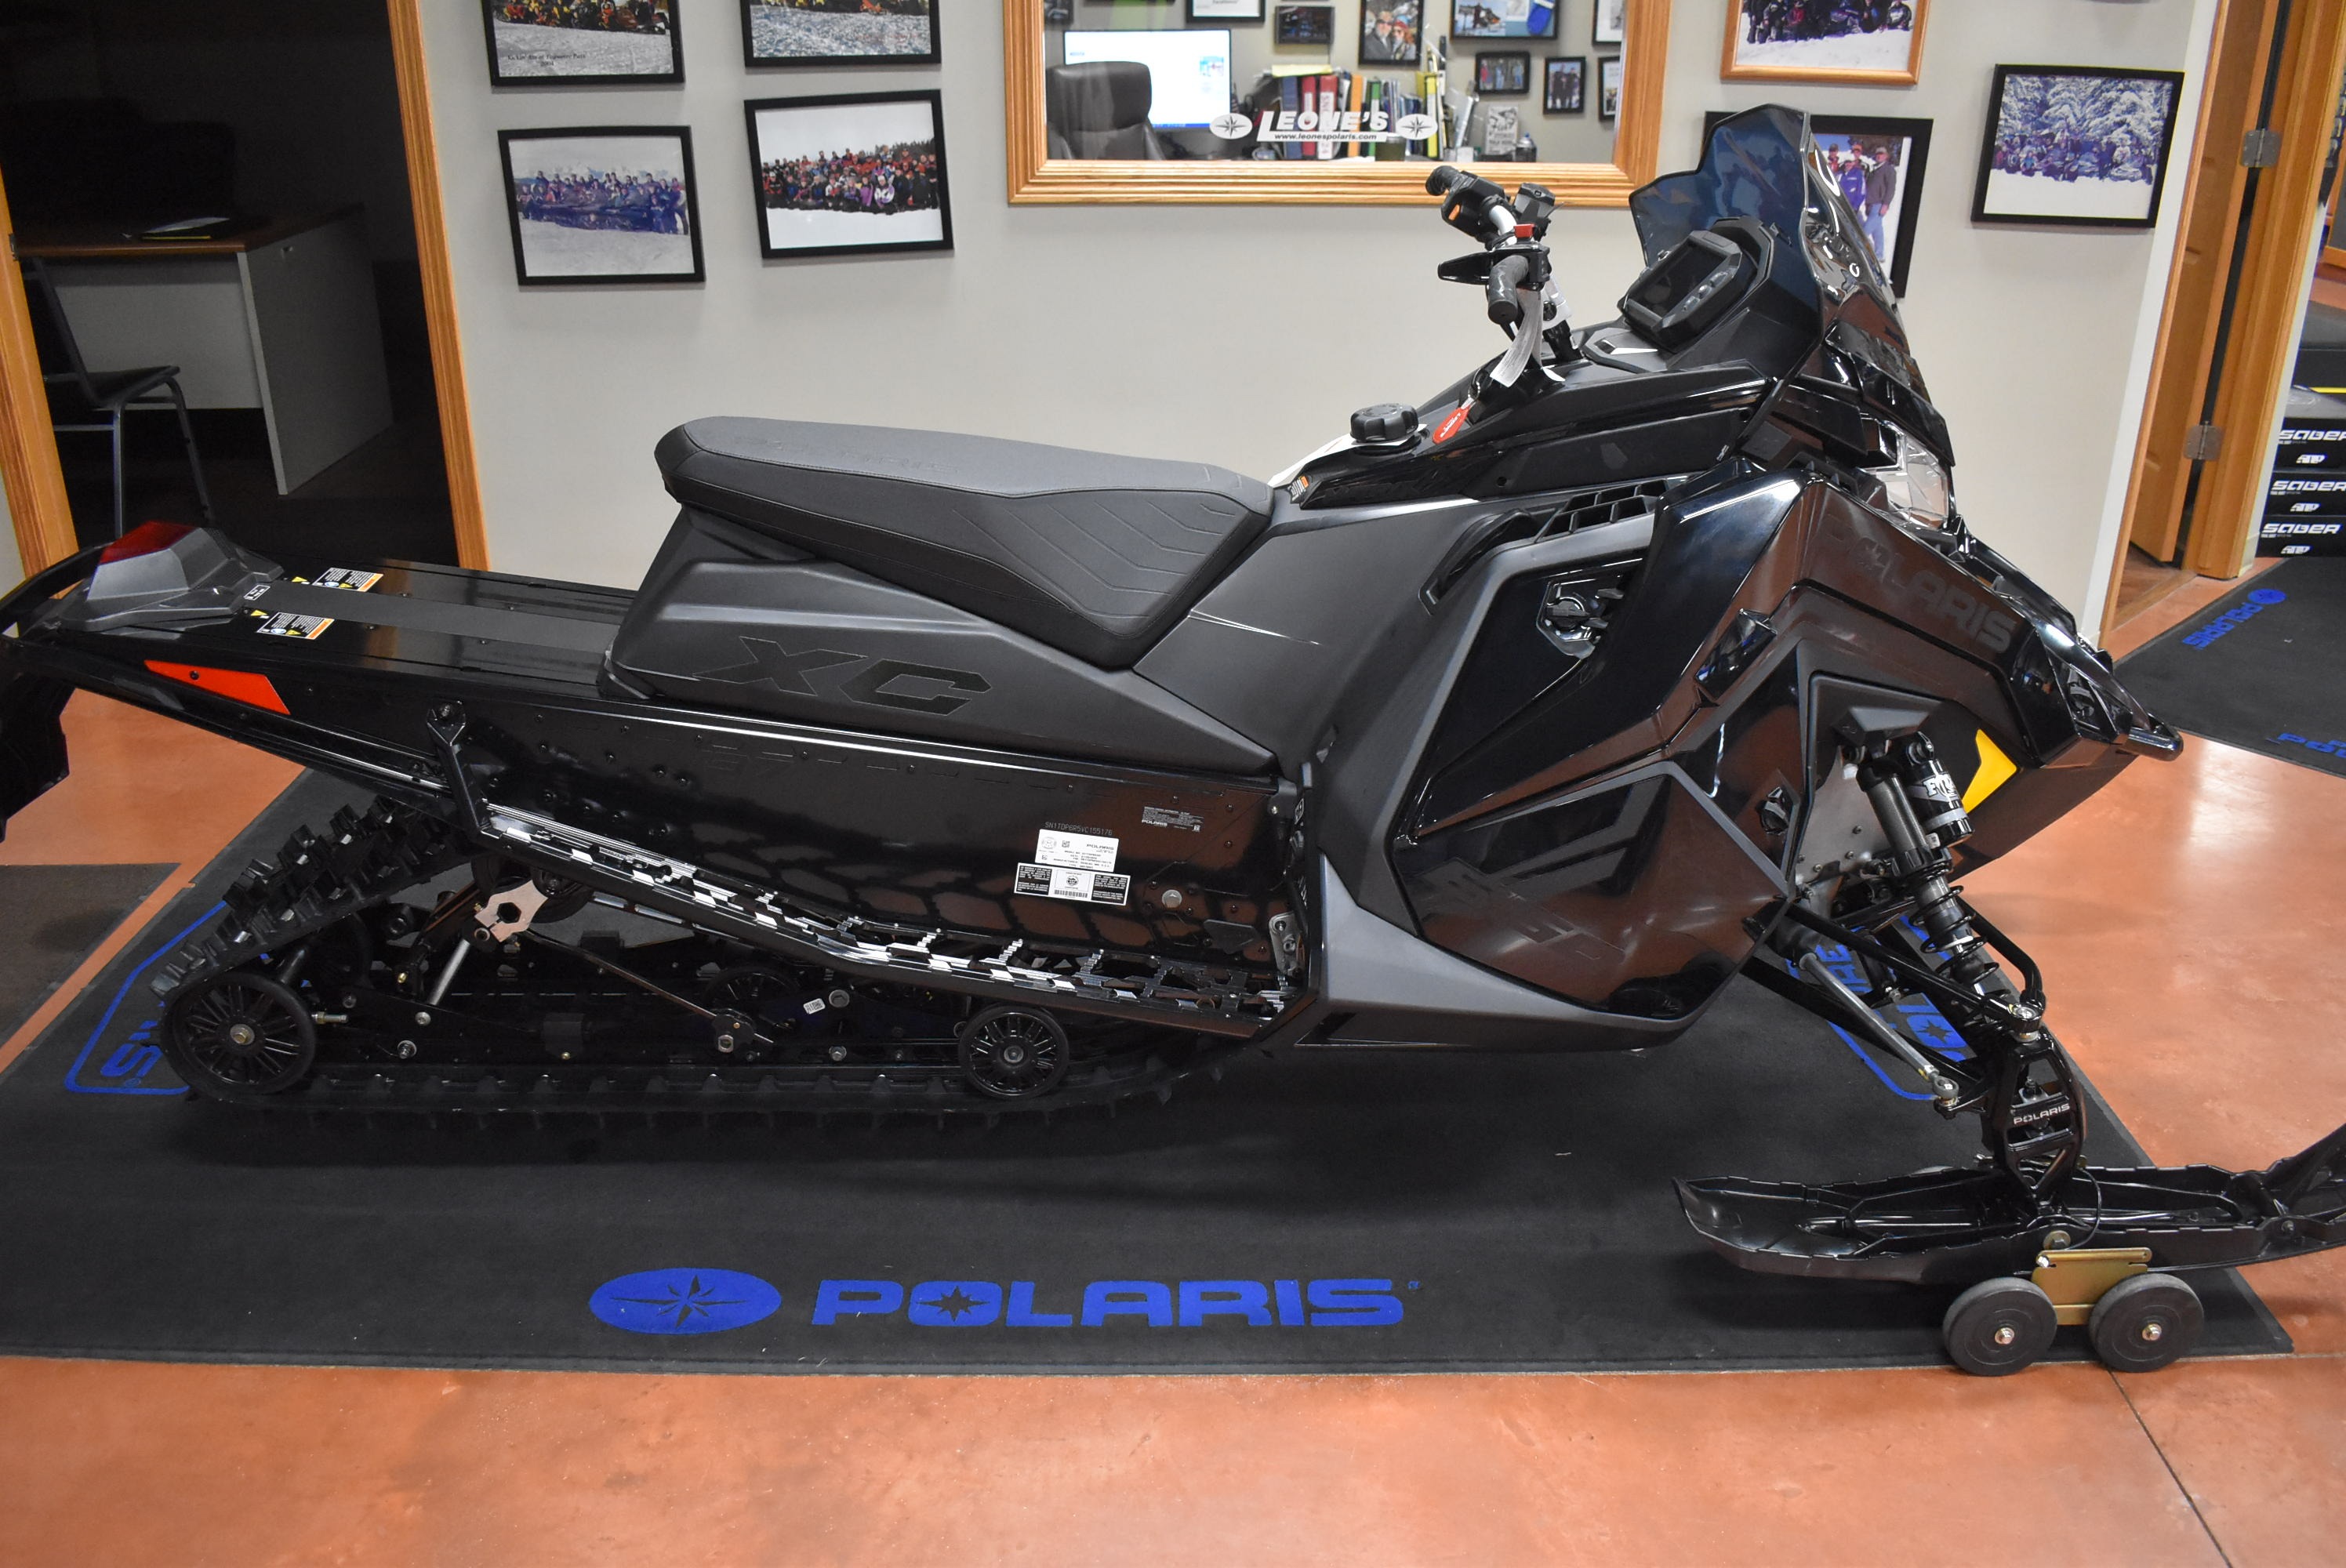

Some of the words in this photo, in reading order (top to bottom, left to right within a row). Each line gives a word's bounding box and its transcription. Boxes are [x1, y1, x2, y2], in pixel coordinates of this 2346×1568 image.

[1258, 111, 1389, 135] LEONE'S
[1274, 132, 1377, 141] www.leonespolaris.com
[2262, 523, 2341, 535] SABER
[1822, 514, 2017, 653] POLARIS
[2182, 601, 2264, 652] POLARIS
[693, 636, 993, 717] XC
[2013, 1102, 2071, 1126] POLARIS
[811, 1279, 1404, 1328] POLARIS
